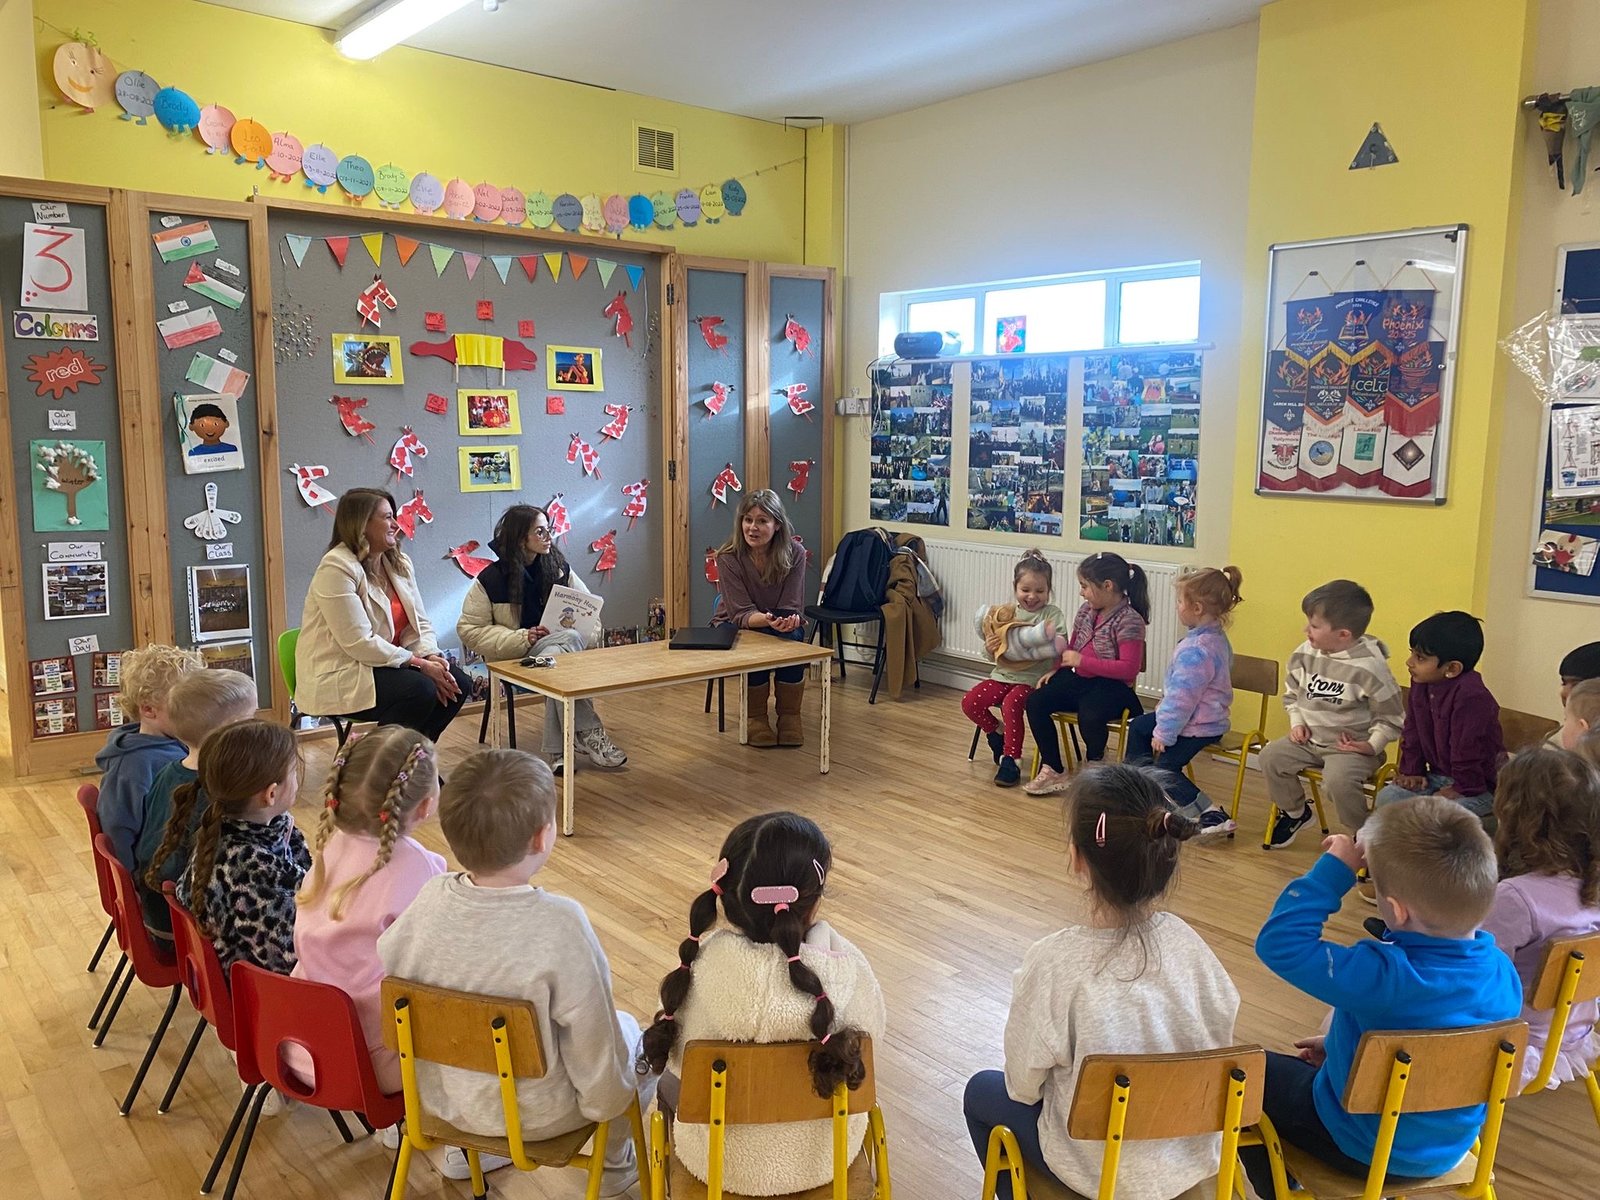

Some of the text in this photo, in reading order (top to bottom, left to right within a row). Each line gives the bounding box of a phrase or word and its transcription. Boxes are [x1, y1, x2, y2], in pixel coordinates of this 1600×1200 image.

[123, 76, 145, 88] Ollie
[160, 95, 189, 114] Brody
[243, 129, 260, 141] Leo
[273, 136, 294, 150] Alma
[344, 160, 365, 172] Theo
[378, 170, 398, 182] Brody
[36, 212, 66, 220] Number
[30, 228, 74, 293] 3
[15, 312, 97, 339] Colours
[1382, 318, 1425, 330] Phoenix
[46, 358, 84, 382] red
[54, 411, 70, 419] Our
[52, 418, 73, 427] Work
[213, 543, 227, 551] Our
[50, 549, 99, 561] Community
[208, 549, 232, 559] Class
[554, 591, 583, 604] Harmony
[583, 599, 598, 611] Hare
[73, 637, 91, 647] Our
